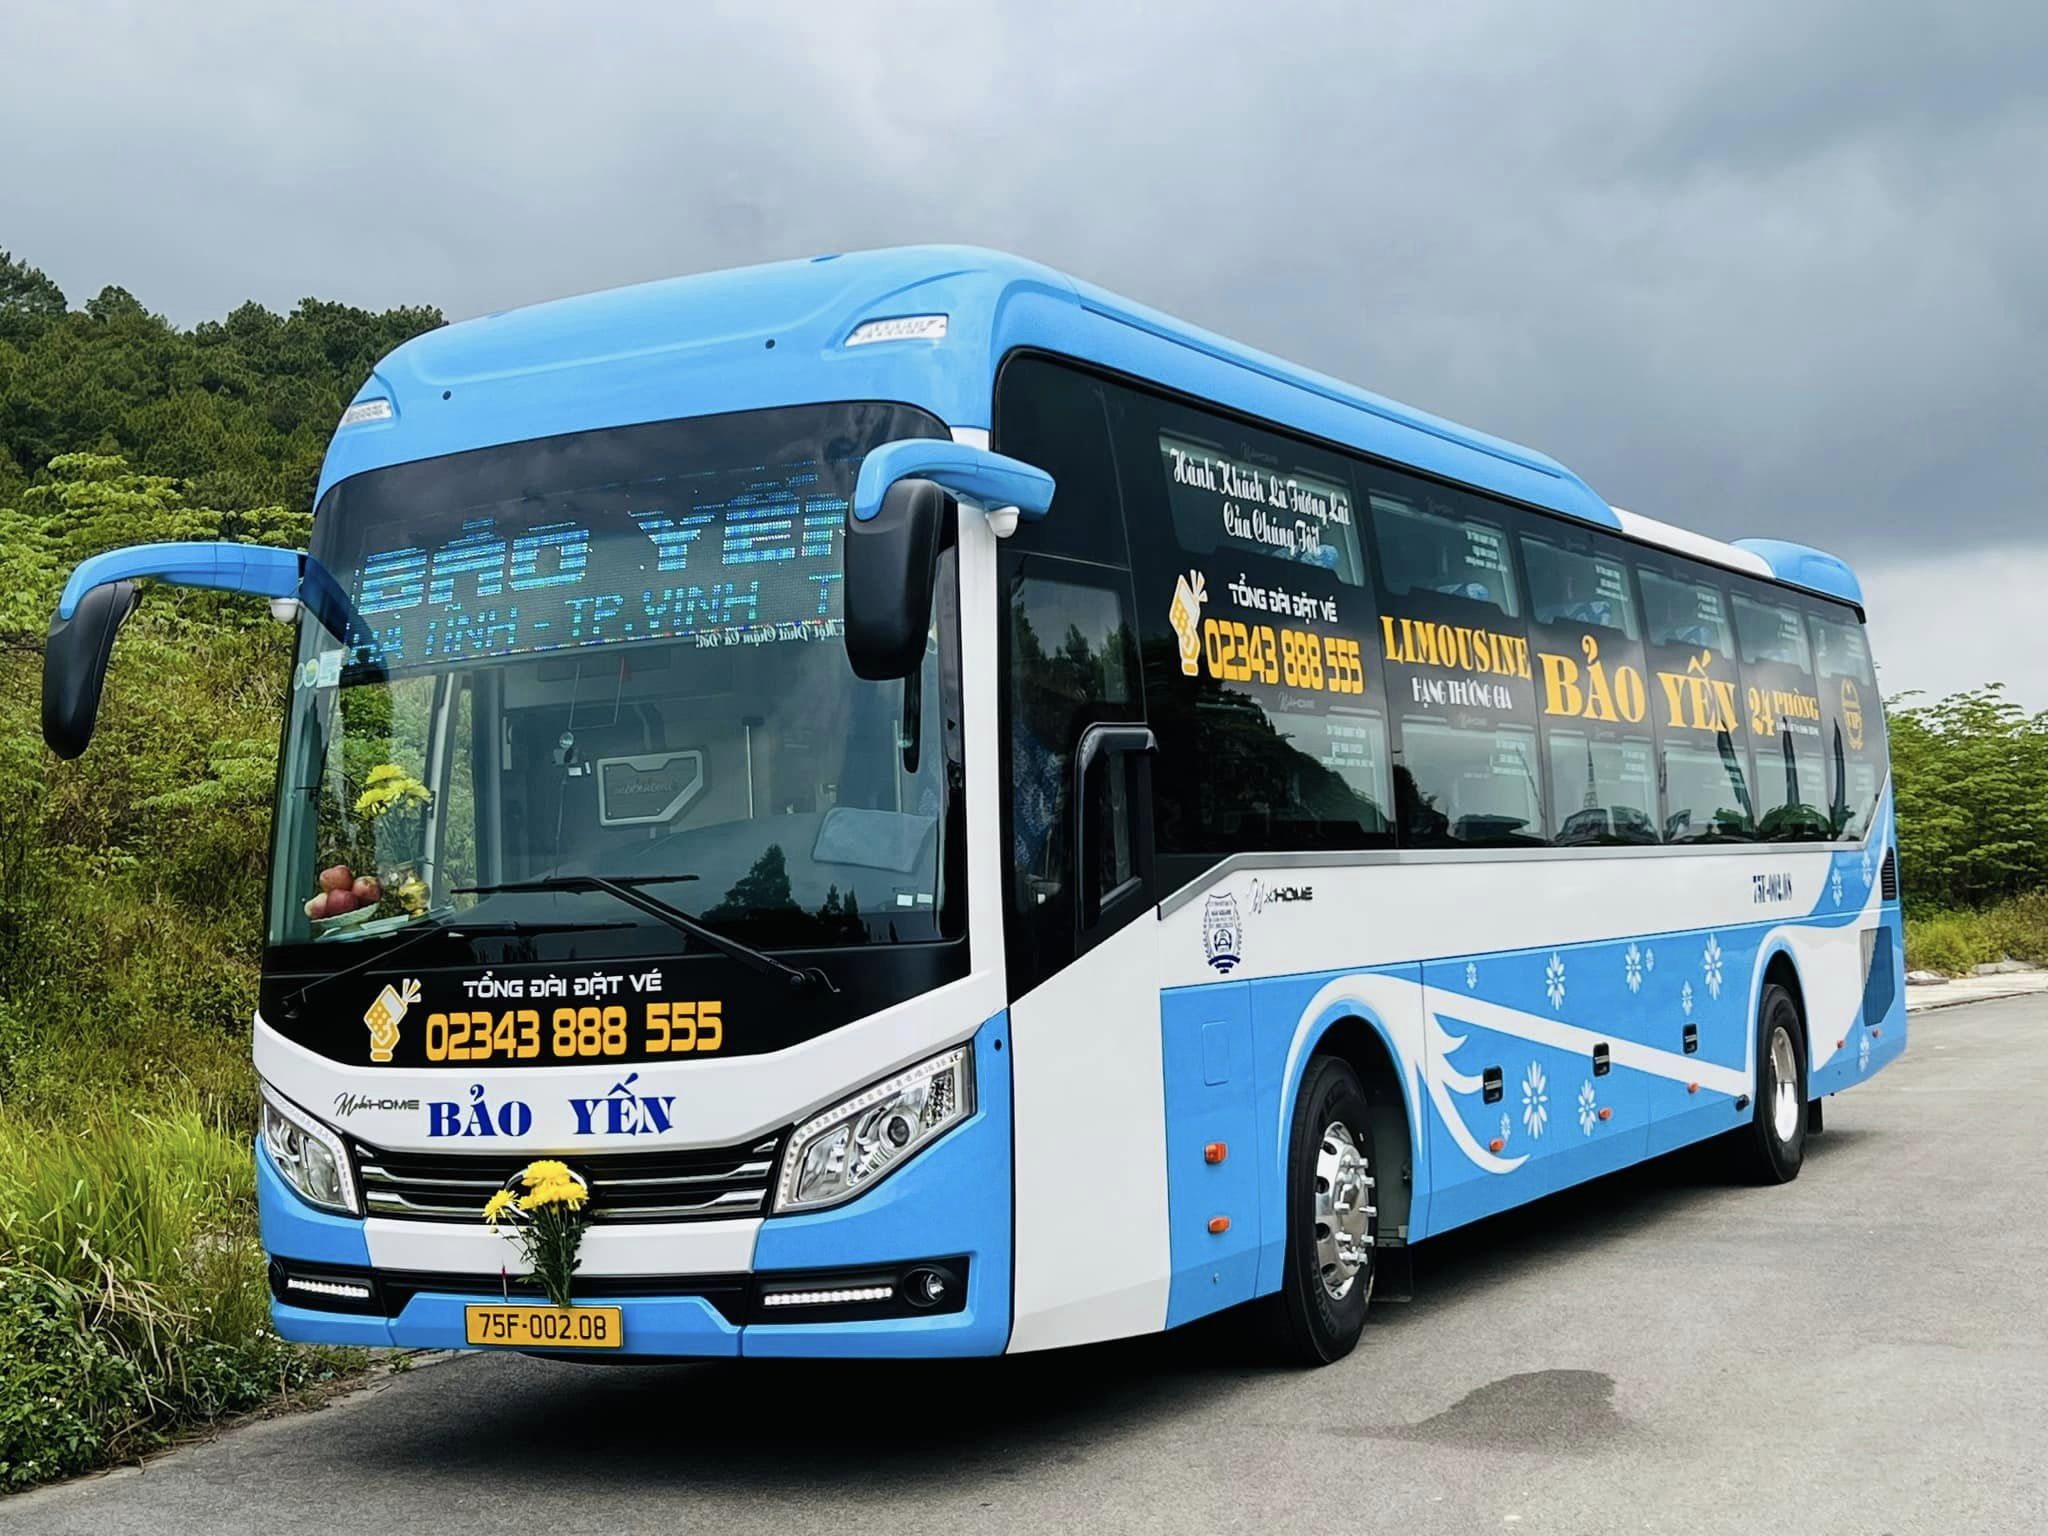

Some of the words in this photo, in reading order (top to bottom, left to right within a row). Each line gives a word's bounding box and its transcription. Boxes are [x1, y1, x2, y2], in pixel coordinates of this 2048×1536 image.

[1170, 448, 1217, 492] Hành
[1215, 460, 1266, 504] Khách
[1223, 501, 1253, 539] Của
[1252, 508, 1297, 556] Chúng
[1228, 573, 1267, 610] TỔNG
[1269, 585, 1292, 616] ĐÀI
[1293, 592, 1318, 624] ĐẶT
[1319, 596, 1338, 623] VÉ
[1204, 618, 1280, 684] 02343
[1280, 628, 1325, 691] 888
[1324, 636, 1364, 694] 555
[1380, 615, 1532, 680] LIMOUSINE
[1537, 634, 1647, 724] BẢO
[1656, 648, 1739, 734] YẾN
[1748, 687, 1775, 736] 24
[1773, 687, 1819, 720] PHÒNG
[463, 971, 524, 999] TỔNG
[529, 975, 568, 998] ĐÀI
[572, 972, 621, 999] ĐẶT
[627, 971, 662, 993] VÉ
[426, 1011, 539, 1061] 02343
[551, 1006, 627, 1057] 888
[645, 1001, 723, 1052] 555
[426, 1083, 533, 1138] BẢO
[568, 1072, 676, 1136] YẾN
[478, 1313, 607, 1340] 75F-002.08
